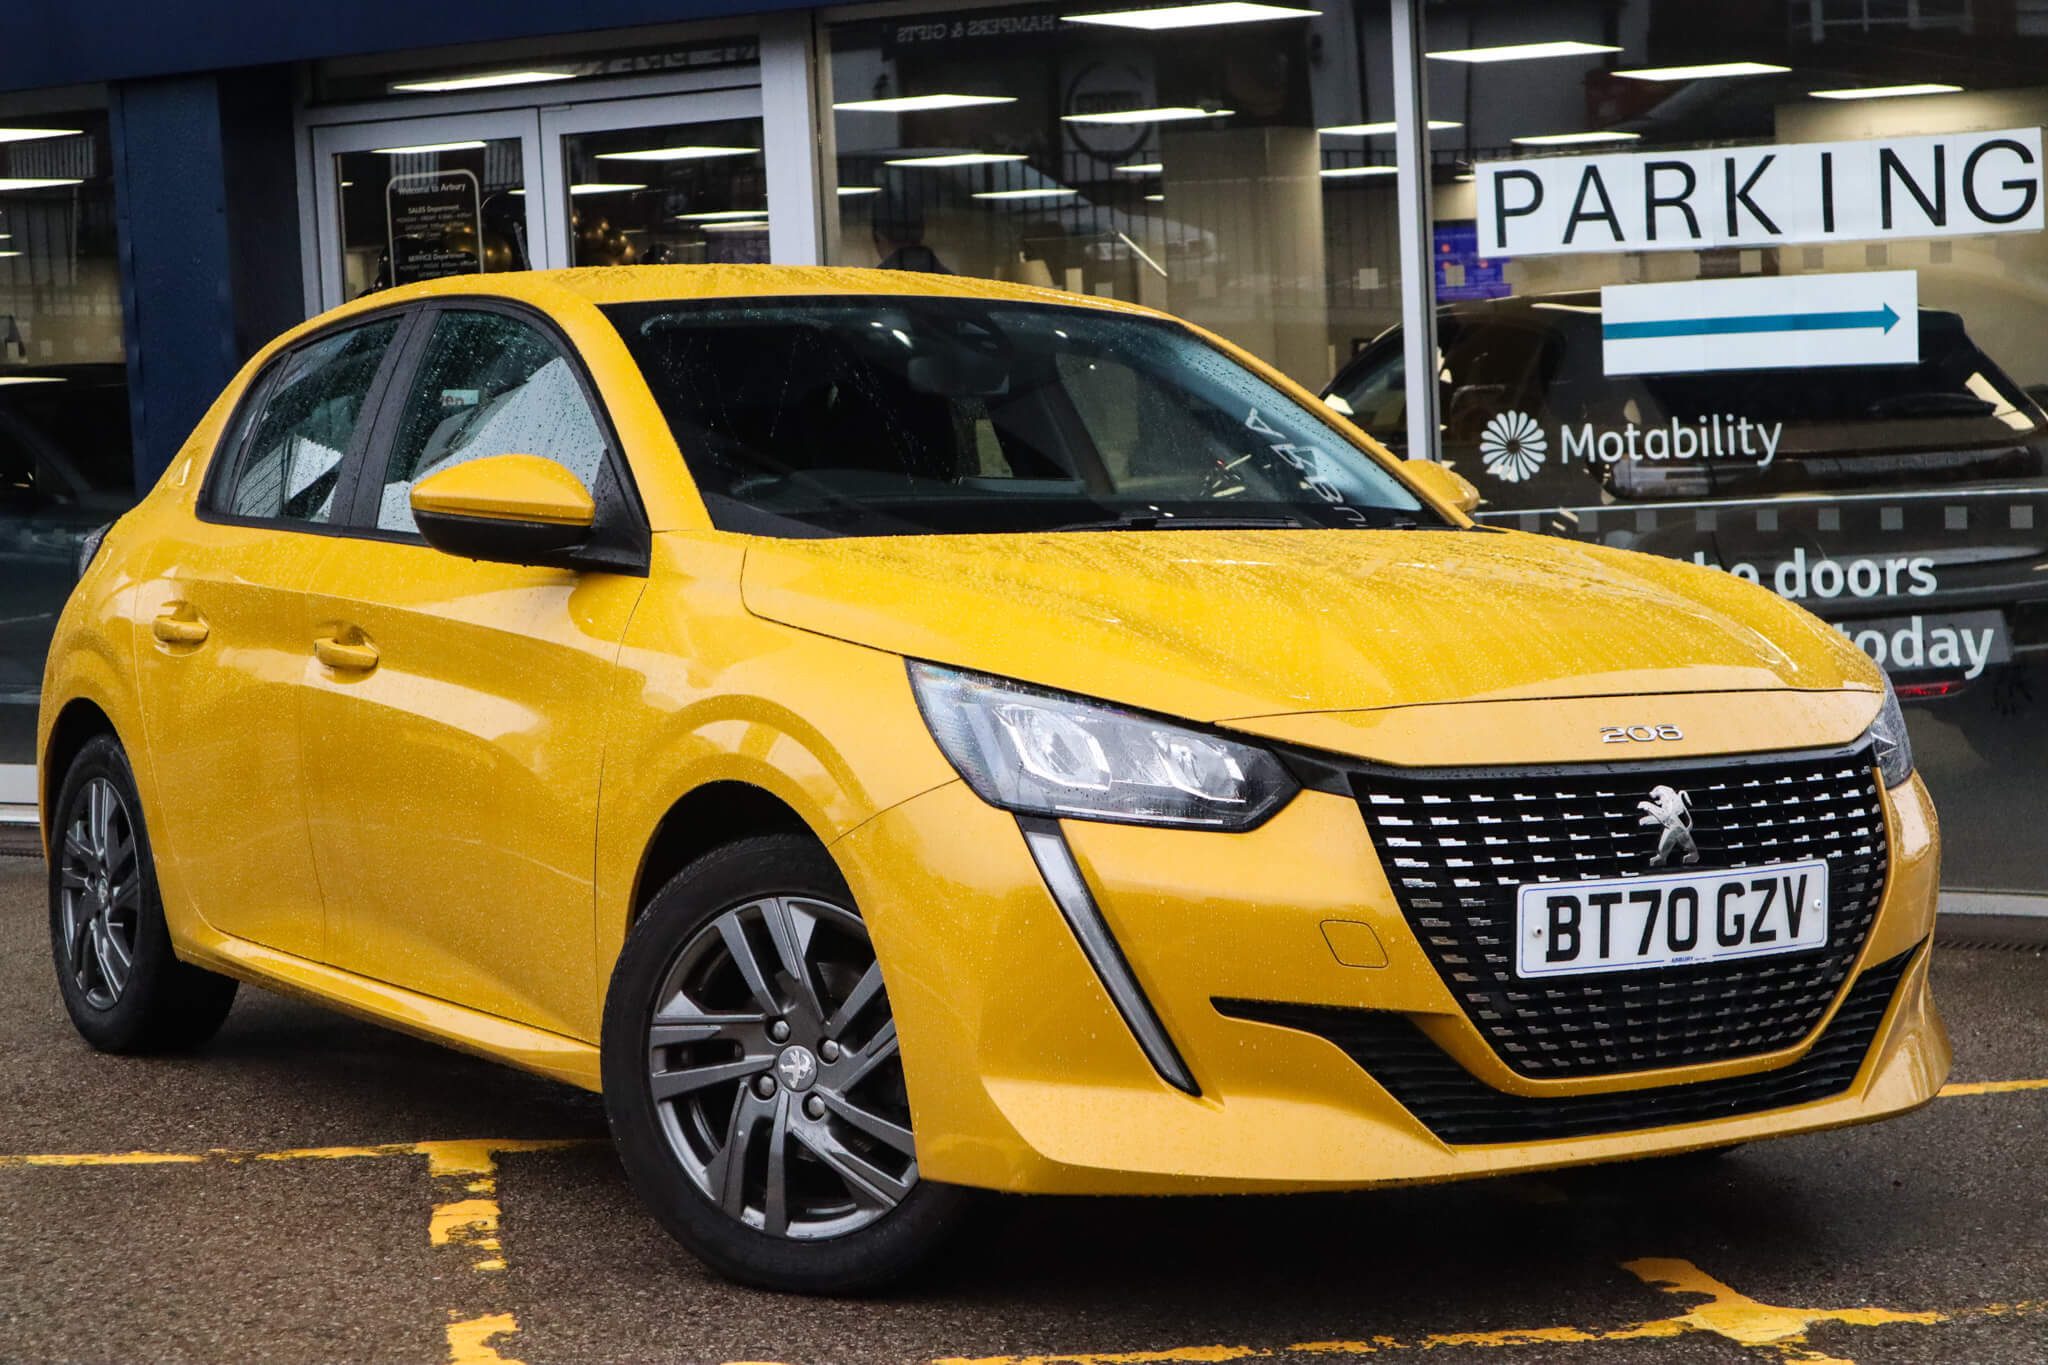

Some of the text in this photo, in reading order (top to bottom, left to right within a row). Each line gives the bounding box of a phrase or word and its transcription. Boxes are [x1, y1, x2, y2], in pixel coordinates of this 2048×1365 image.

[440, 183, 466, 192] Arbury
[1493, 138, 2038, 249] PARKING
[1561, 411, 1783, 467] Motability
[1774, 547, 1938, 599] doors
[1599, 724, 1684, 744] 208
[1545, 874, 1808, 963] BT70 GZV
